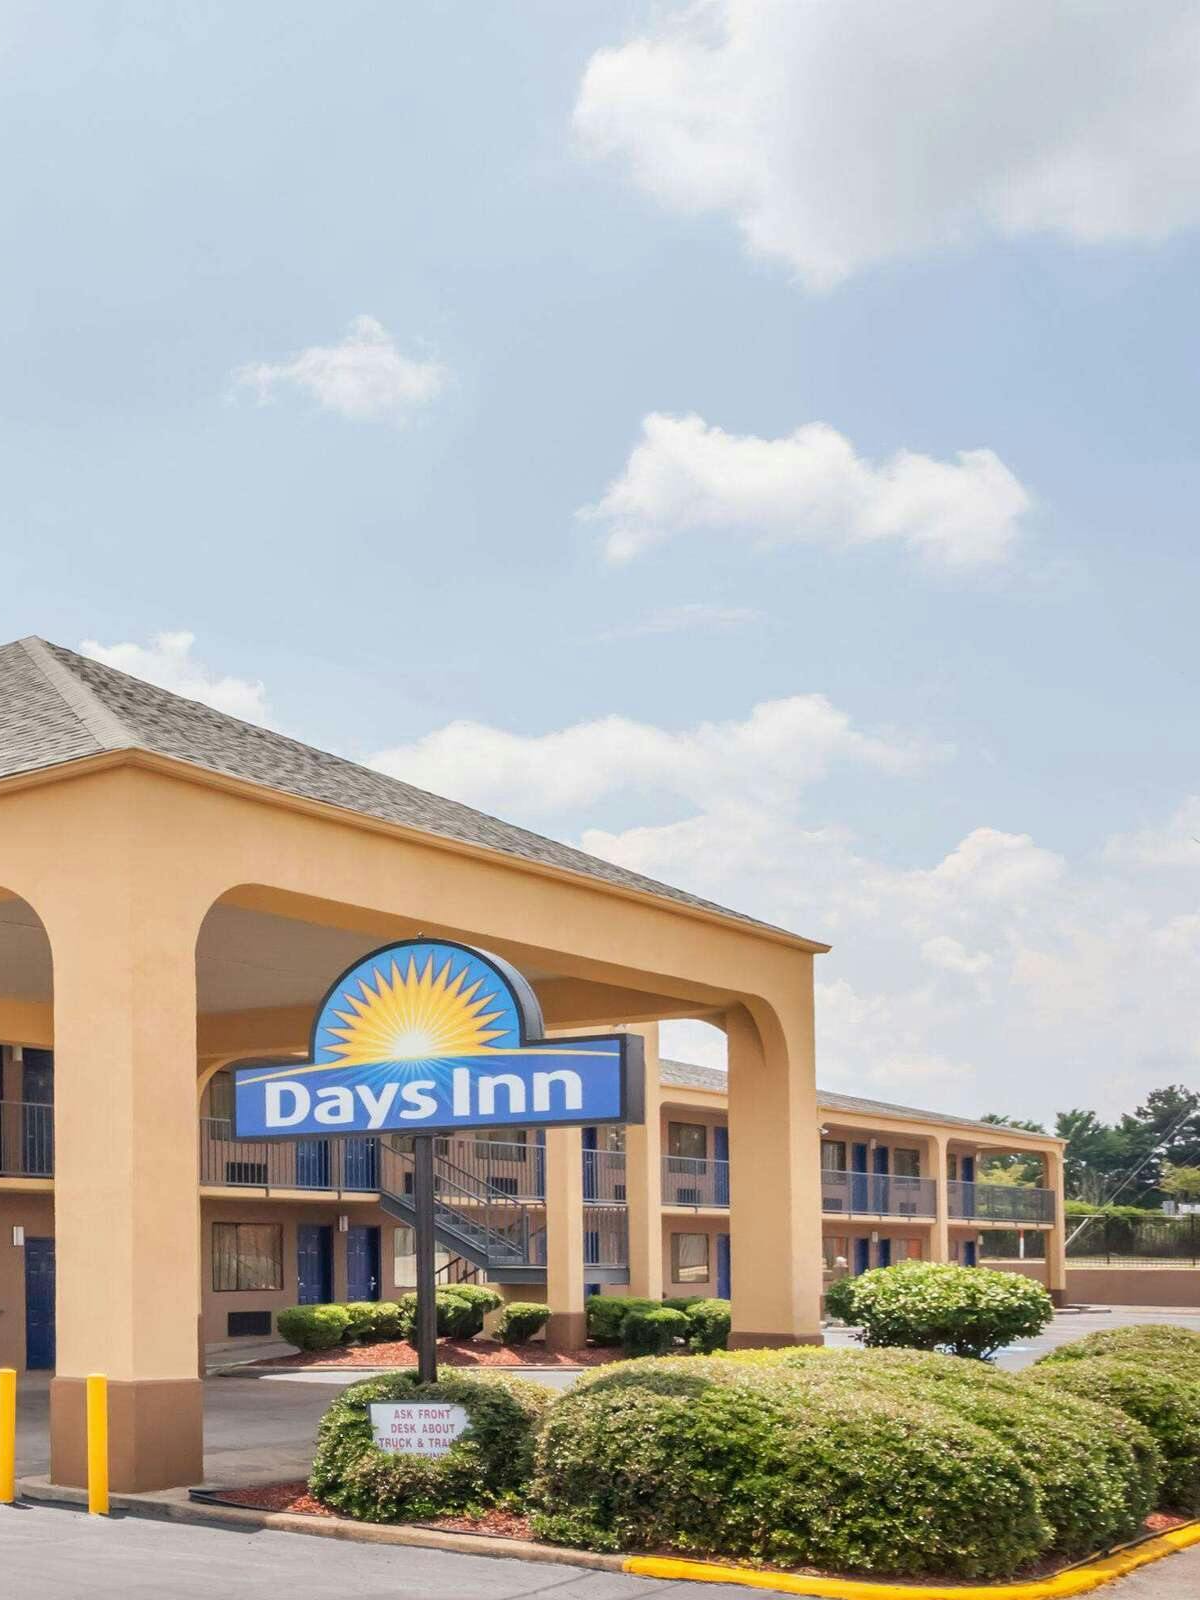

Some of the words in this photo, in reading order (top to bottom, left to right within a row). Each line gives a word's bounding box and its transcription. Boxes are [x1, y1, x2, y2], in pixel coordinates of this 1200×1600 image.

[265, 1079, 438, 1129] Days
[453, 1067, 583, 1116] Inn
[394, 1409, 413, 1420] ASK
[418, 1409, 451, 1420] FRONT
[391, 1423, 416, 1434] DESK
[422, 1423, 455, 1434] ABOUT
[379, 1437, 412, 1448] TRUCK
[417, 1437, 424, 1448] &
